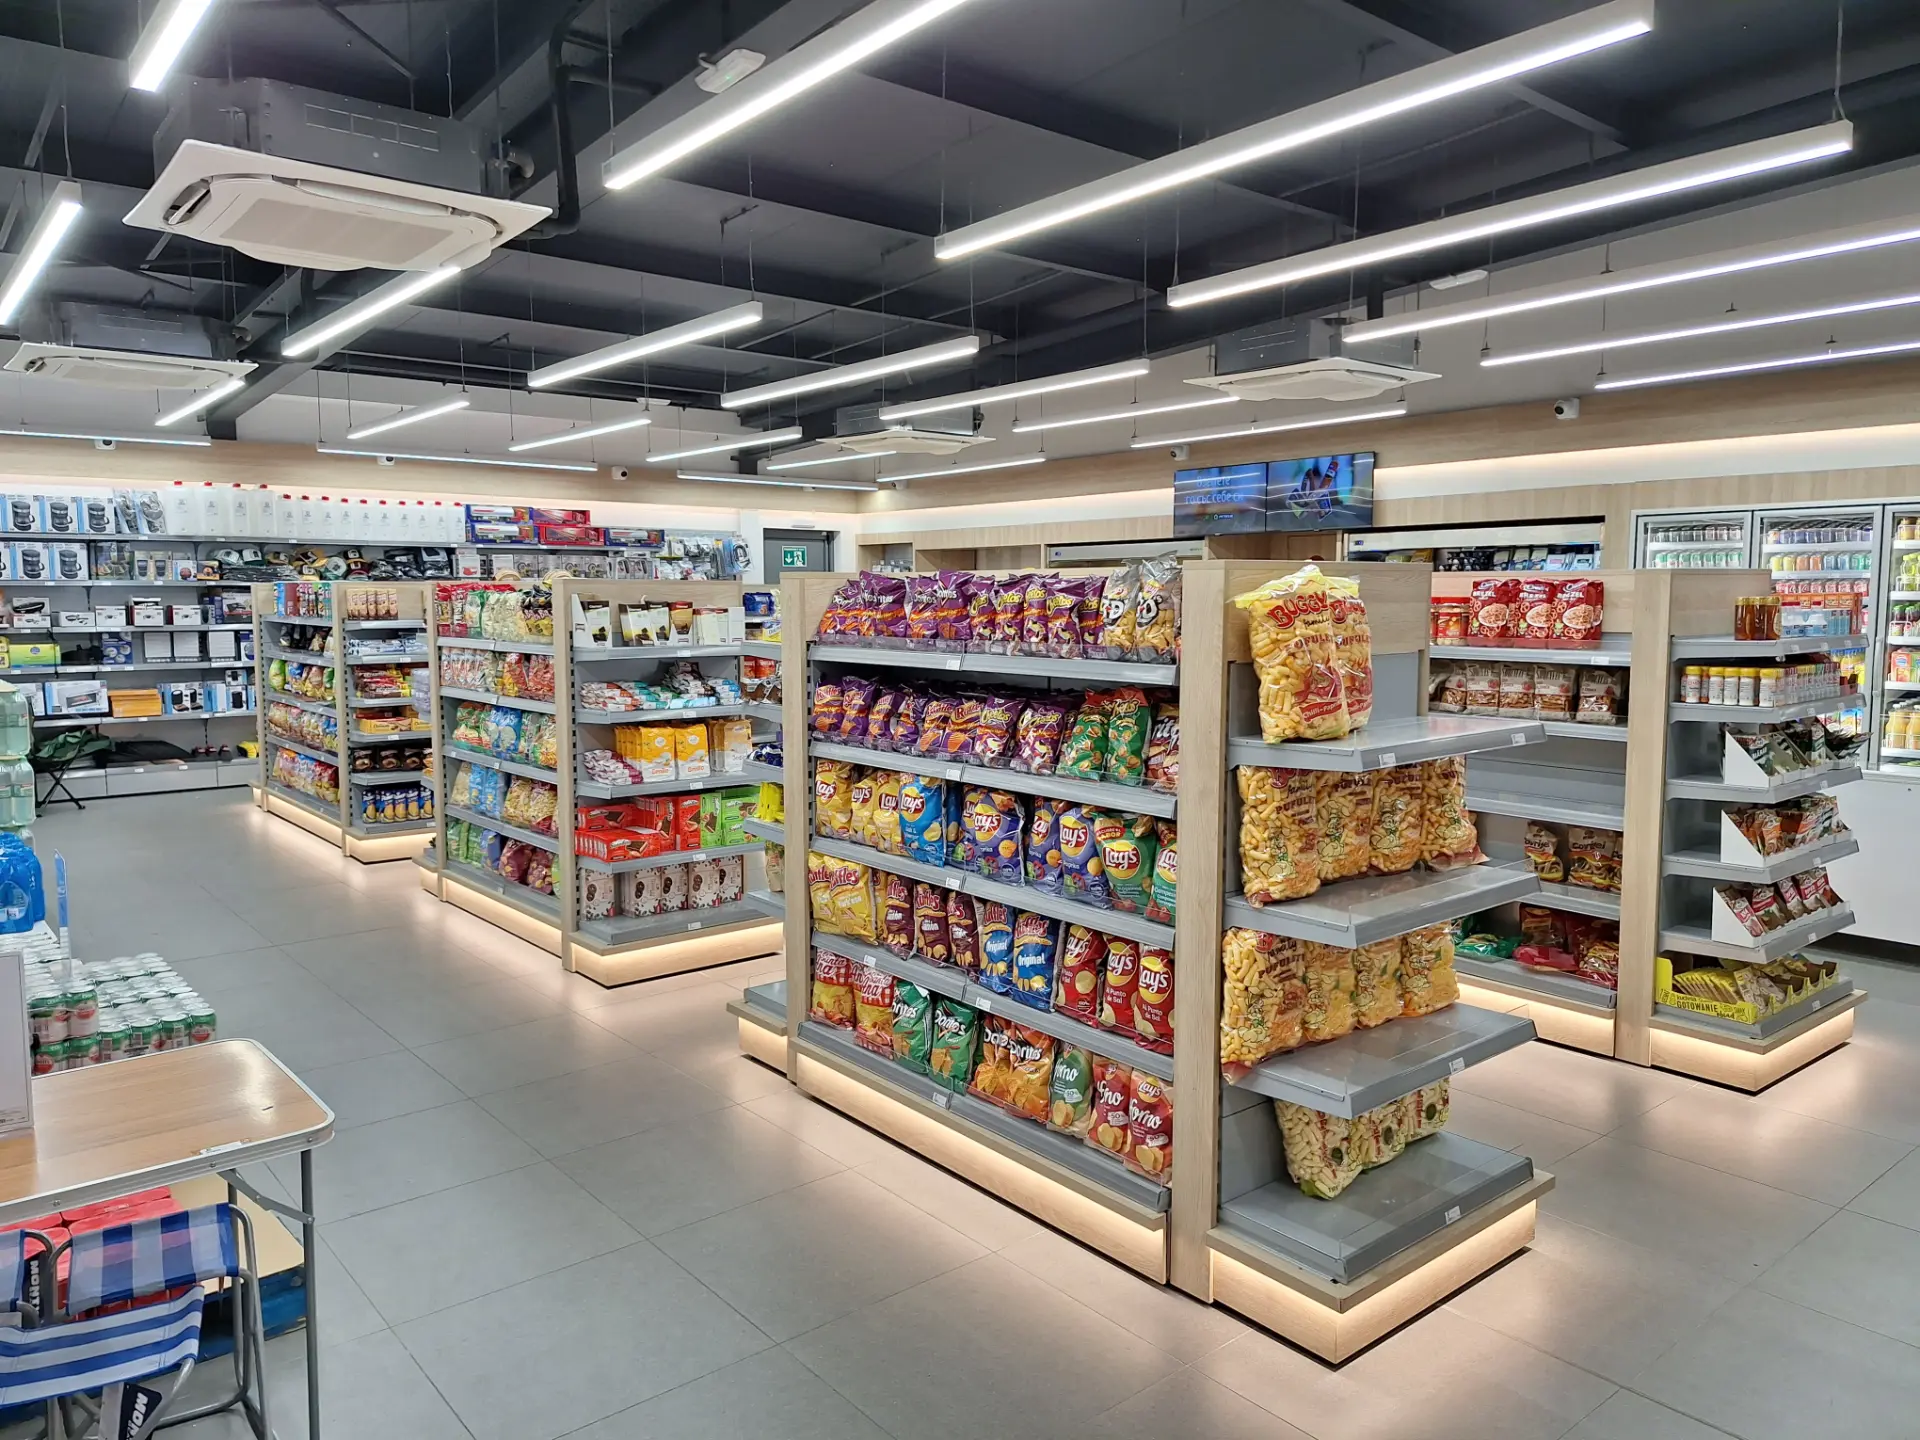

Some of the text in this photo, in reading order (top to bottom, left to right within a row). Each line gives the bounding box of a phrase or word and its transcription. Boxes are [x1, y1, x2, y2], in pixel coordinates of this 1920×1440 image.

[1267, 591, 1329, 629] BUGGY
[900, 793, 923, 814] Lay's
[1105, 847, 1139, 870] Lay's
[985, 939, 1008, 953] Original
[1018, 953, 1046, 967] Original
[1107, 952, 1134, 976] Lay's
[1139, 965, 1169, 993] Lay's
[1110, 988, 1127, 998] Punto
[1147, 1006, 1163, 1016] Punto
[1676, 1001, 1718, 1012] GOTOWANIE
[935, 1009, 967, 1036] Doritos
[1010, 1040, 1043, 1061] Doritos
[1138, 1081, 1161, 1097] Lay's
